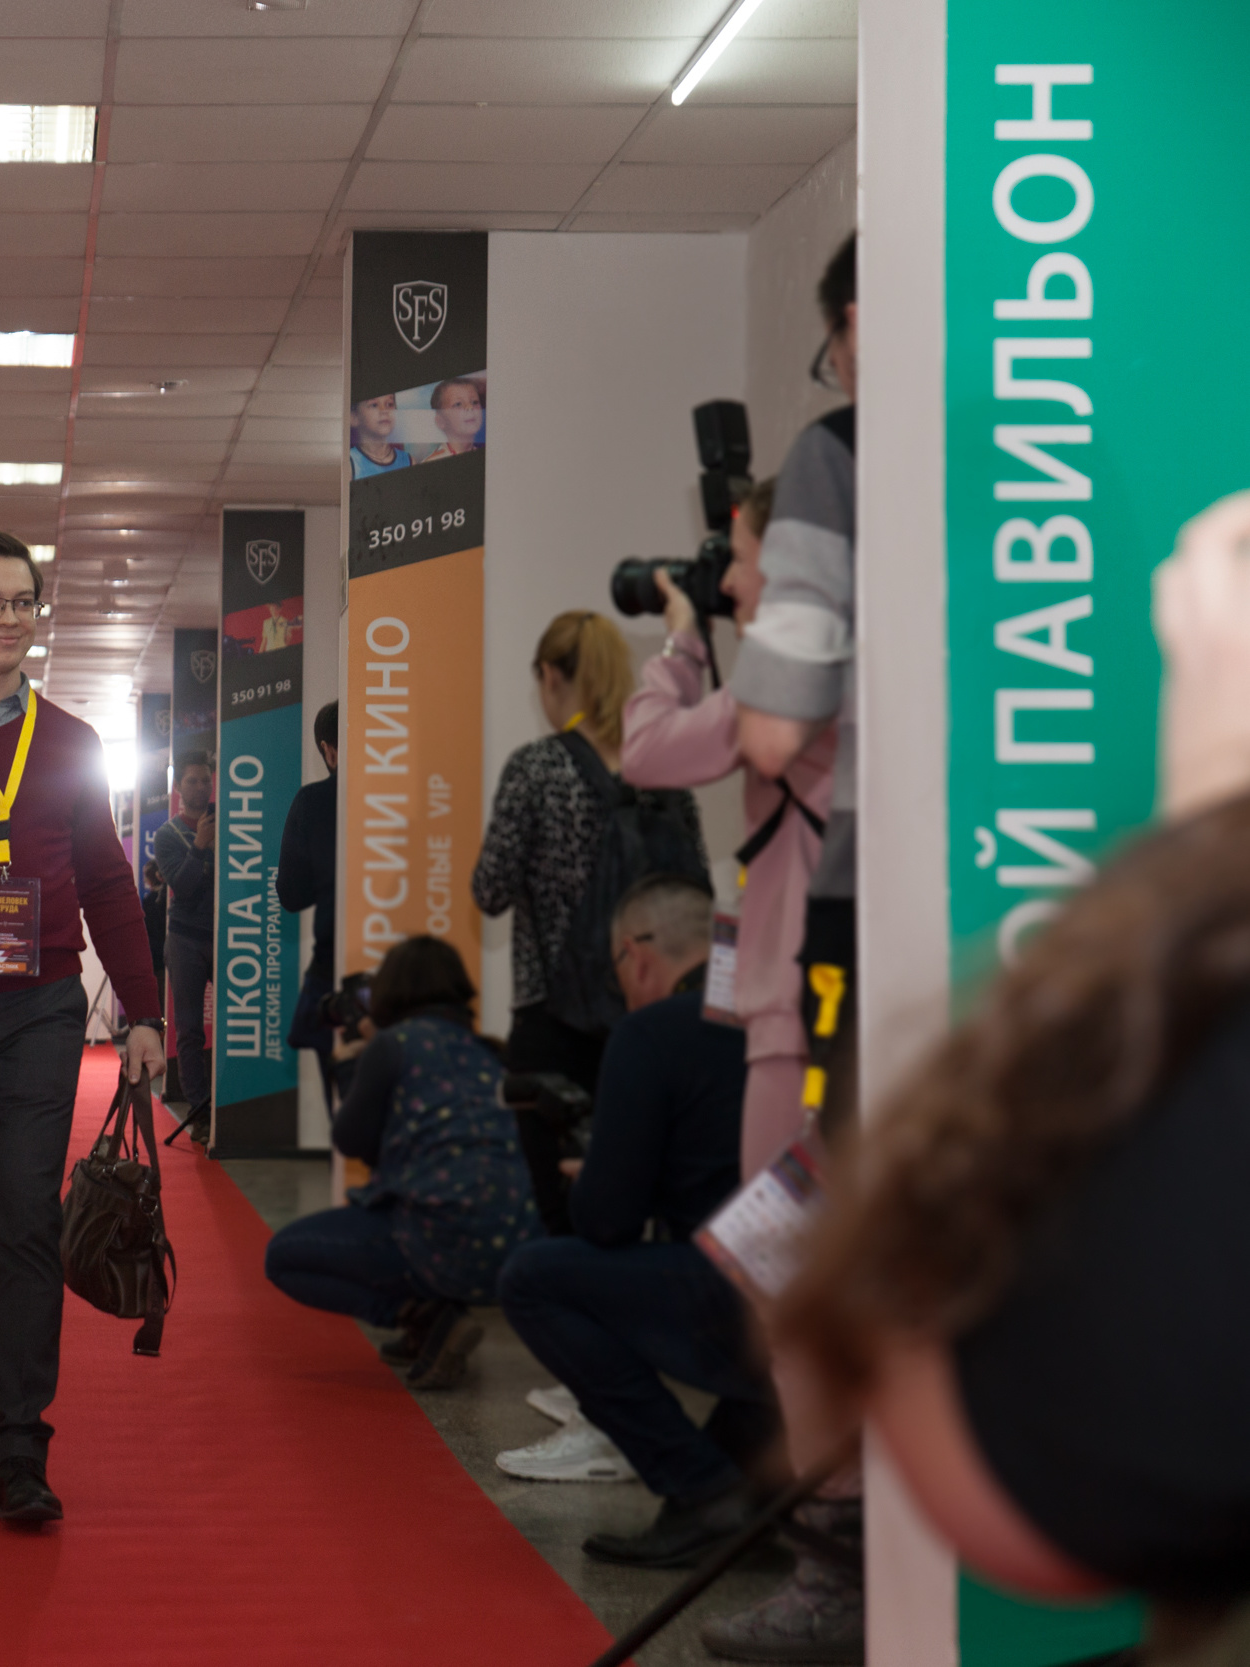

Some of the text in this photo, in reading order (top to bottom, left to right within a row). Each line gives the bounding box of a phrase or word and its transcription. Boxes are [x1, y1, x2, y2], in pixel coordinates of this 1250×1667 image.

[399, 287, 443, 340] SFS
[991, 62, 1096, 764] ПАВИЛЬОН
[368, 507, 466, 549] 350 91 98
[250, 544, 277, 576] SFS
[231, 678, 291, 705] 350 91 98
[364, 616, 411, 774] КИНО
[427, 773, 452, 818] VIP
[226, 755, 264, 1058] ШКОЛА КИНО
[265, 866, 282, 1061] ДЕТСКИЕ ПРОГРАММЫ
